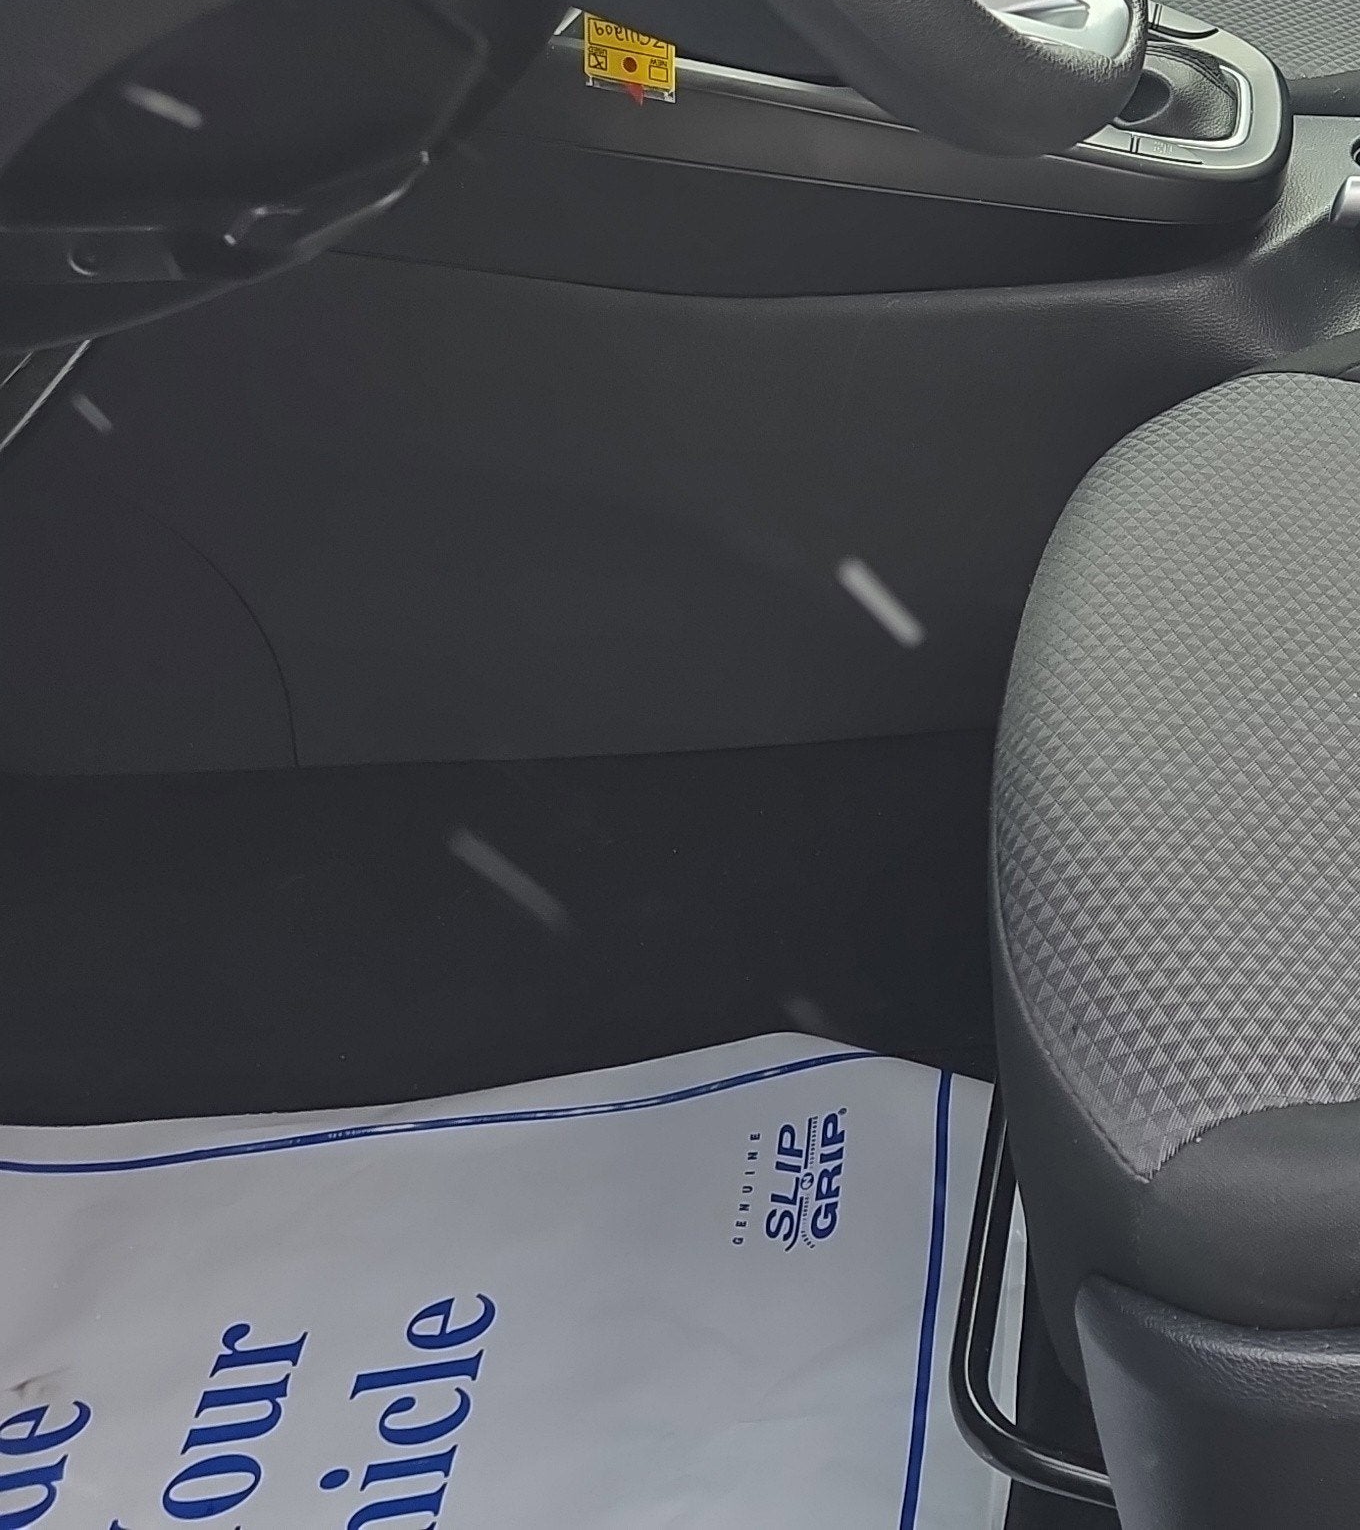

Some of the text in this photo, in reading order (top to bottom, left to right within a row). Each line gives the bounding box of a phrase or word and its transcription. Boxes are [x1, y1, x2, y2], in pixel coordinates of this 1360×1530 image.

[732, 1132, 761, 1246] GENUINE
[765, 1123, 803, 1243] SLIP
[810, 1112, 846, 1240] GRIP
[109, 1322, 309, 1530] our
